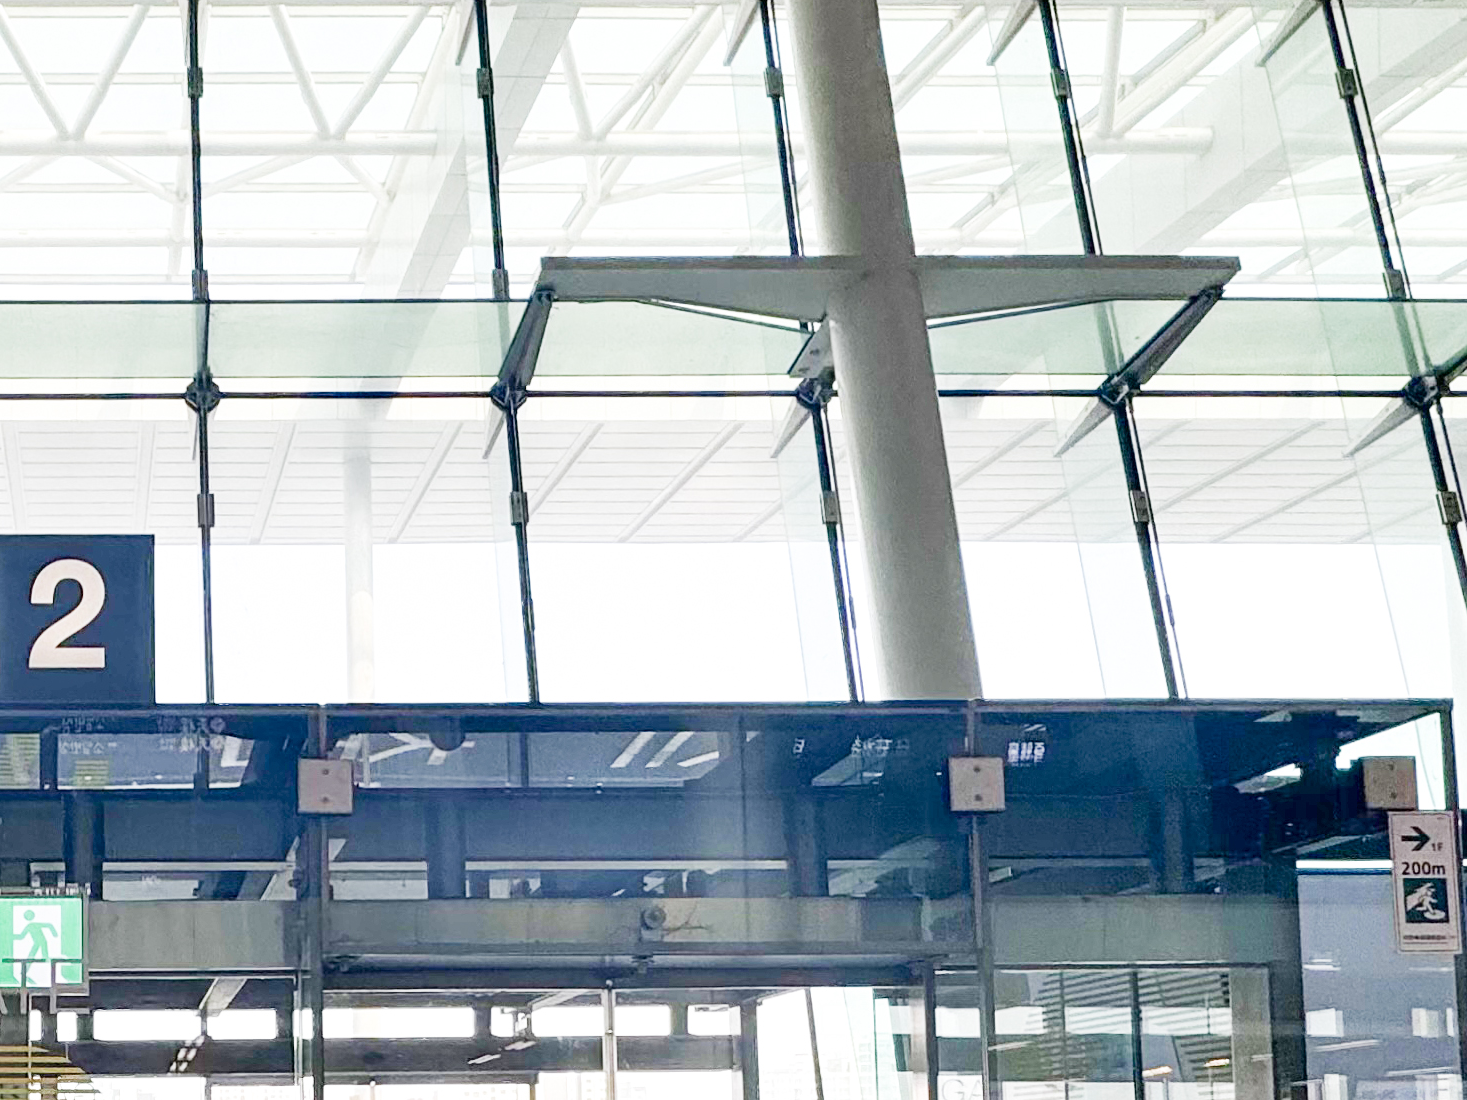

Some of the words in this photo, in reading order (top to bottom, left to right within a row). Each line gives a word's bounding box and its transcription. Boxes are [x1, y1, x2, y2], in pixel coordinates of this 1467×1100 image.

[28, 558, 106, 669] 2
[1431, 842, 1443, 852] 1F
[1401, 861, 1446, 876] 200m
